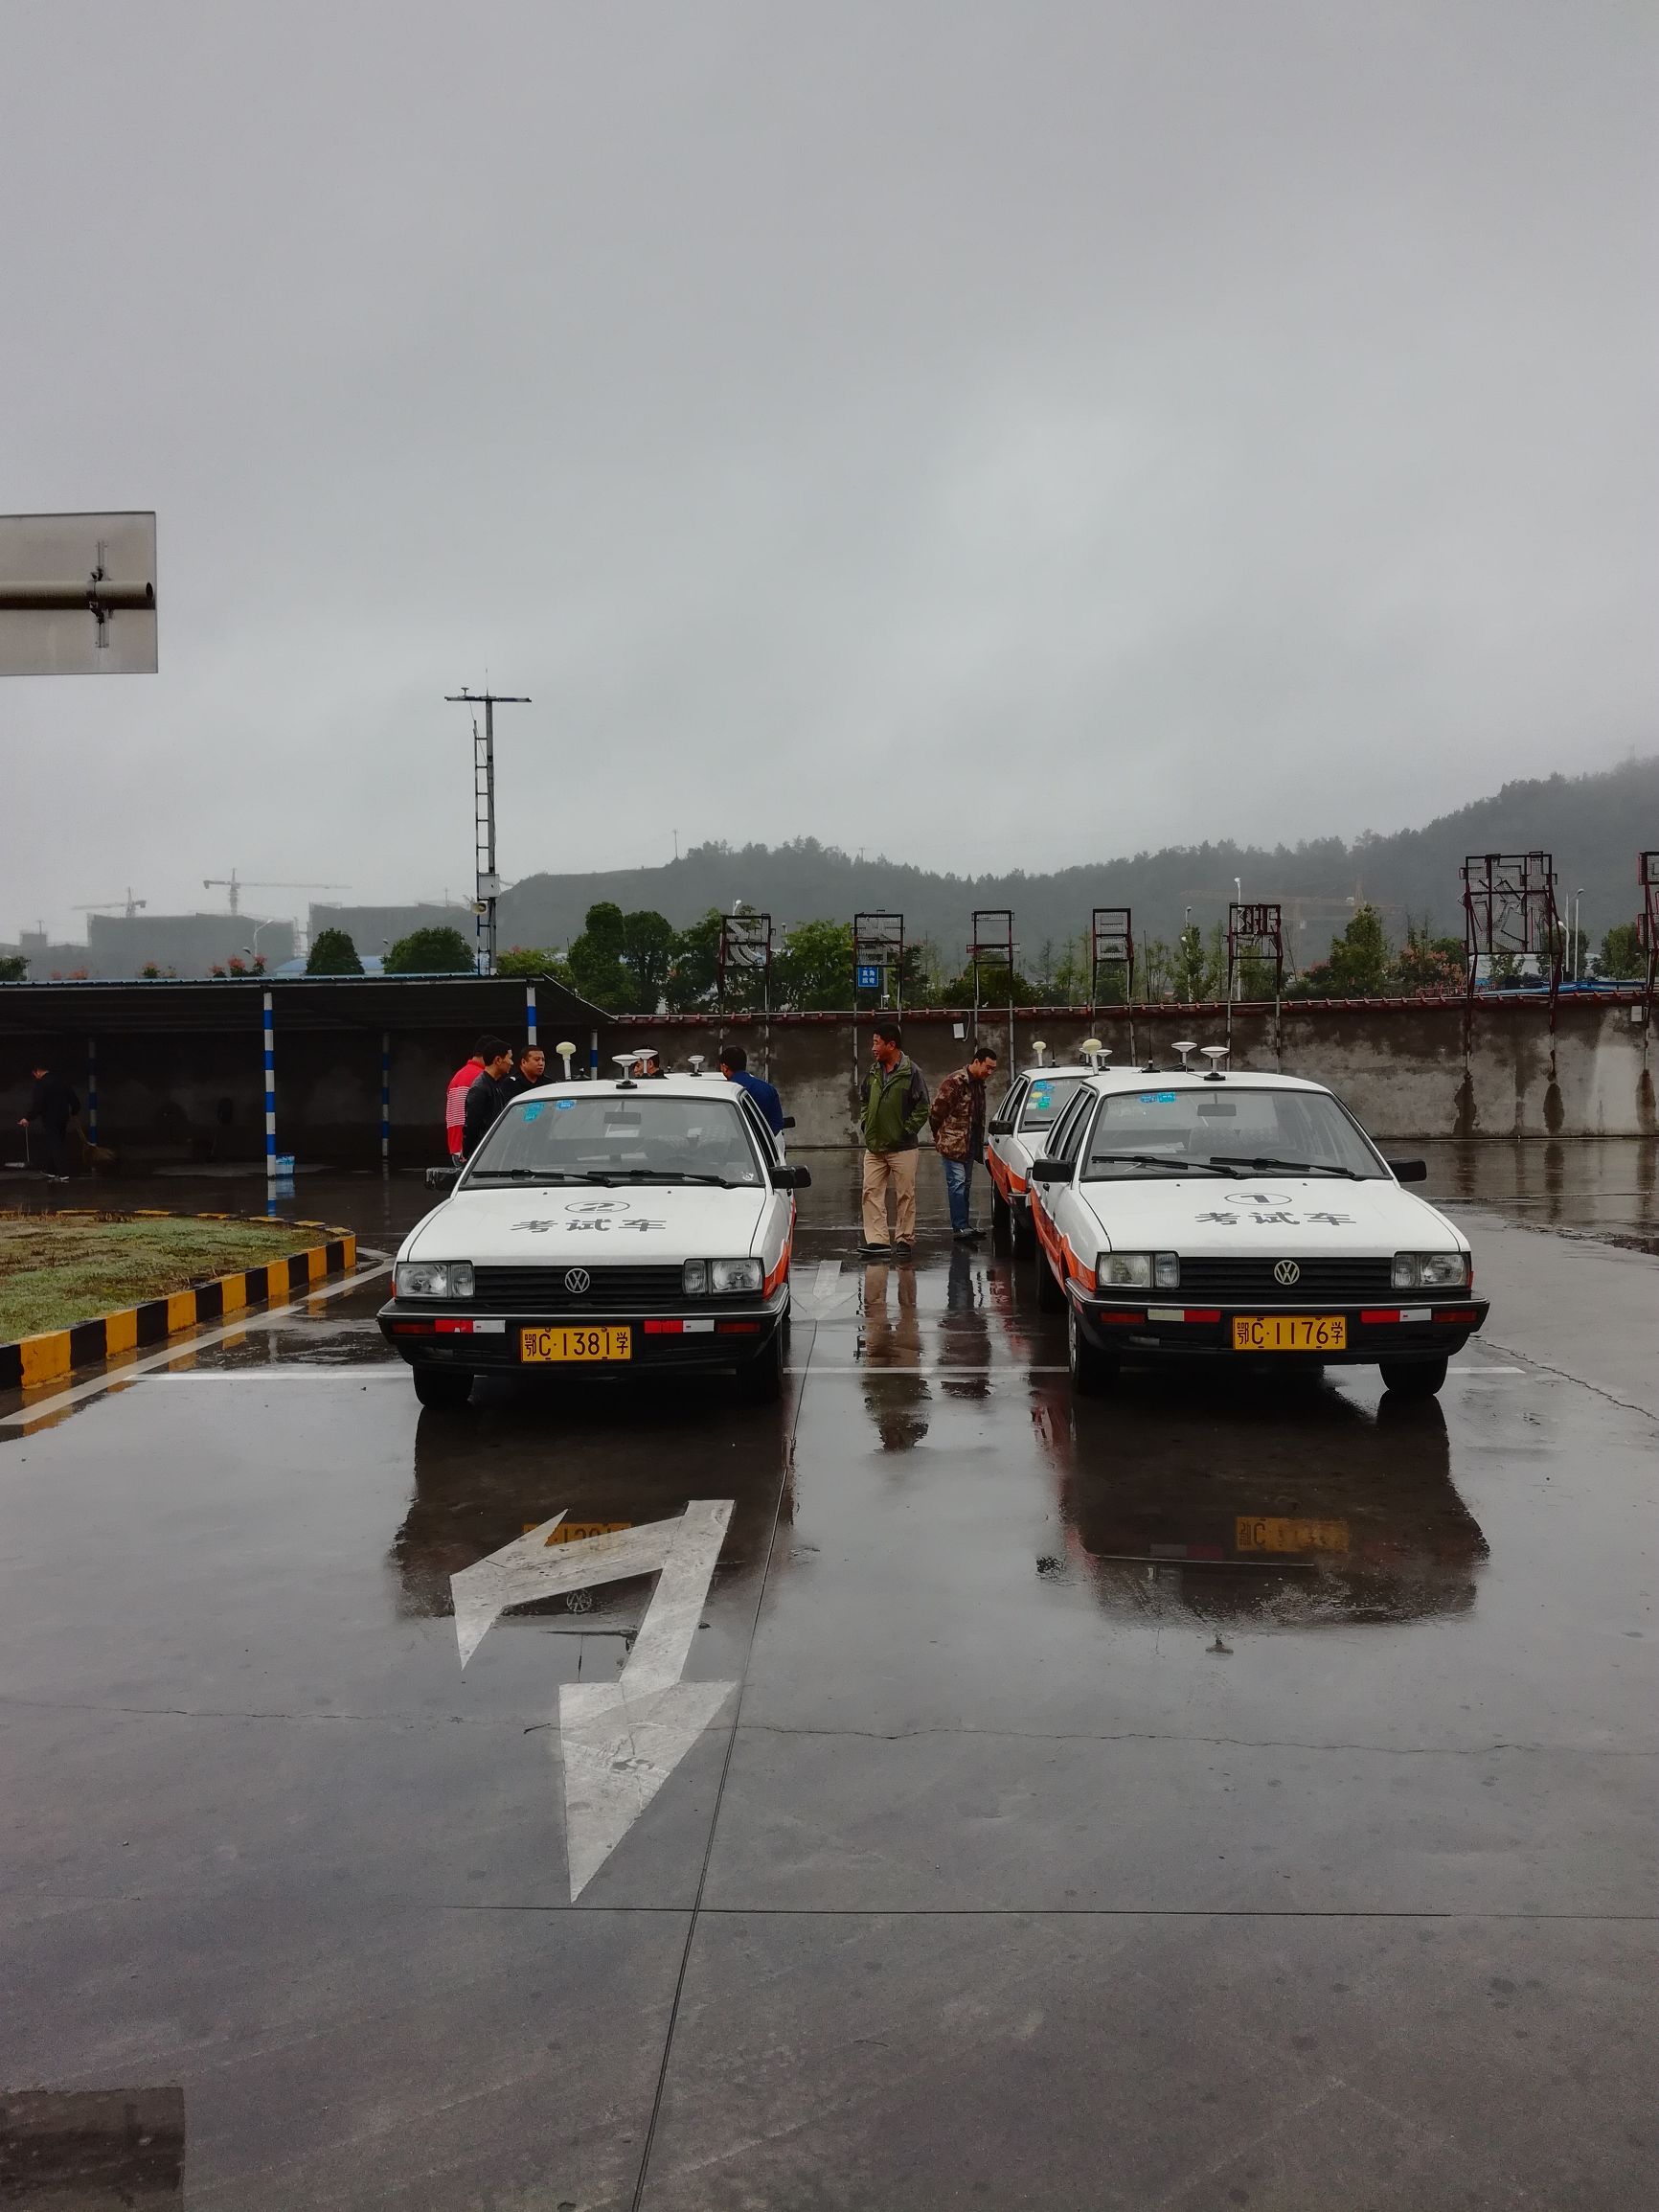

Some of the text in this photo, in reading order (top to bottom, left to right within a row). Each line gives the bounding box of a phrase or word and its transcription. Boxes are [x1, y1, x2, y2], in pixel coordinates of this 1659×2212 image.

[1194, 1211, 1357, 1226] 考试车
[510, 1219, 668, 1233] 考试车
